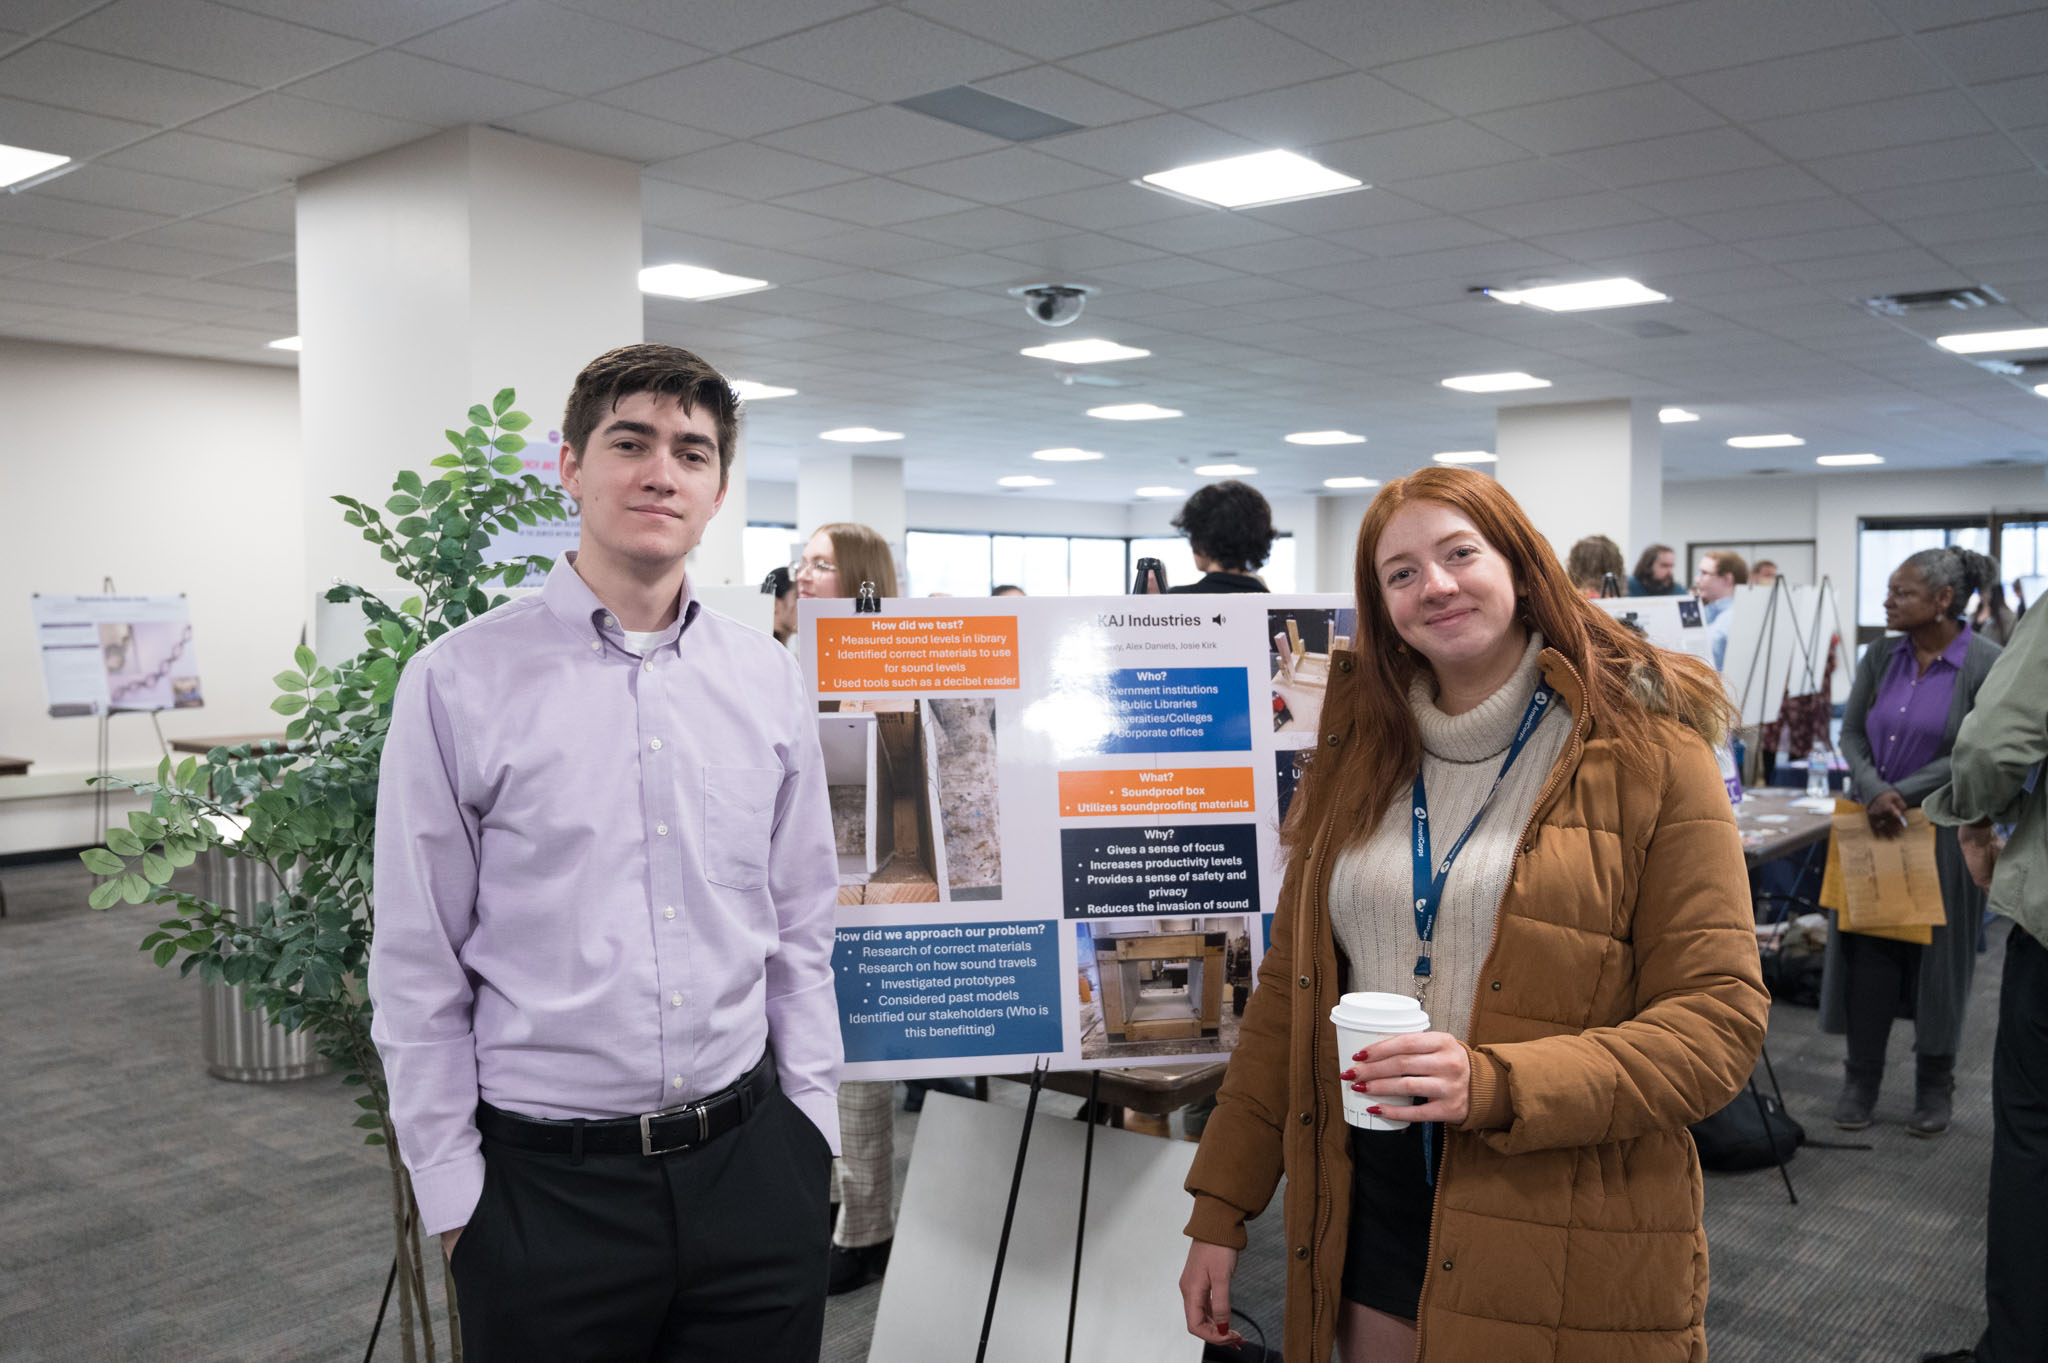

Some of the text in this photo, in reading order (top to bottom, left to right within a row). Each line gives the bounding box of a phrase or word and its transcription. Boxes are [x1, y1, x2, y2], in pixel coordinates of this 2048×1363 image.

[871, 620, 964, 630] How did we test?
[1098, 613, 1201, 627] KAJ Industries
[841, 634, 1007, 645] Measured sound levels in library
[1126, 642, 1143, 650] Alex
[1145, 642, 1178, 650] Daniels,
[838, 650, 887, 659] Identified
[889, 650, 927, 658] correct
[929, 648, 977, 658] materials
[979, 649, 990, 657] to
[884, 662, 965, 673] for sound levels
[833, 678, 860, 688] Used
[863, 677, 889, 687] tools
[892, 677, 917, 687] such
[943, 676, 981, 686] decibel
[984, 676, 1017, 686] reader
[1137, 672, 1167, 681] Who?
[1101, 685, 1218, 696] overnment institutions
[1121, 699, 1197, 709] Public Libraries
[1518, 705, 1539, 741] AmeriCorps
[1118, 727, 1204, 739] Corporate offices
[1139, 772, 1174, 782] What?
[1121, 787, 1205, 799] Soundproof box
[1077, 799, 1249, 813] Utilizes soundproofing materials
[1144, 829, 1175, 841] Why?
[1107, 845, 1137, 855] Gives
[1148, 846, 1180, 854] sense
[1182, 843, 1193, 853] of
[1195, 842, 1225, 852] focus
[1090, 856, 1242, 871] Increases productivity levels
[1087, 874, 1134, 885] Provides
[1145, 875, 1176, 883] sense
[1179, 872, 1190, 882] of
[1191, 871, 1225, 883] safety
[1227, 870, 1247, 880] and
[1149, 887, 1188, 899] privacy
[1088, 898, 1249, 914] Reduces the invasion of sound
[835, 924, 1045, 942] How did we approach our problem?
[863, 940, 1032, 957] Research of correct materials
[859, 956, 1037, 974] Research on how sound travels
[881, 974, 1016, 991] Investigated prototypes
[878, 990, 1019, 1006] Considered past models
[849, 1005, 1049, 1024] Identified our stakeholders (Who is
[905, 1023, 995, 1038] this benefitting)
